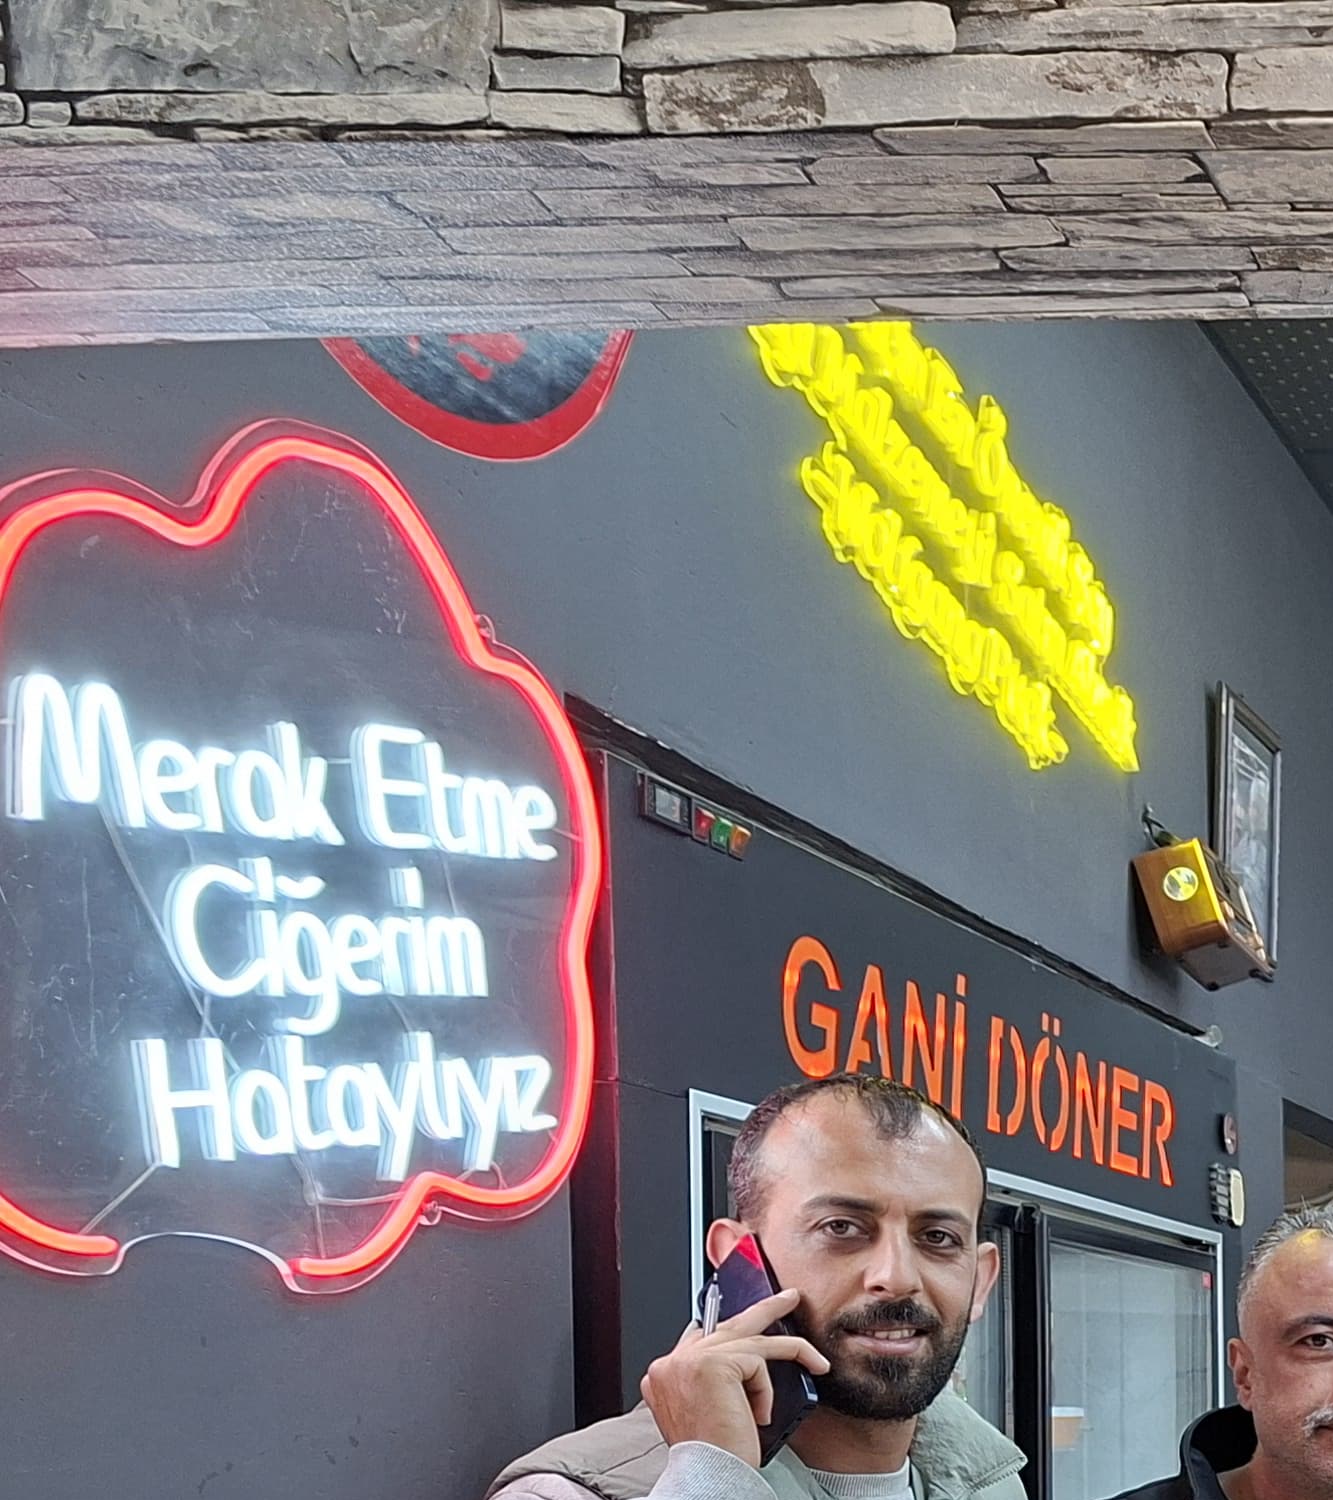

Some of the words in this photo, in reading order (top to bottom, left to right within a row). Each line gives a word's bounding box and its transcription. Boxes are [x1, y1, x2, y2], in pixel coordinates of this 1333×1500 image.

[6, 673, 344, 847] Merak
[350, 726, 558, 861] Etme
[163, 856, 489, 1036] Ciğerim
[130, 1031, 558, 1181] Hataylıyız
[781, 936, 968, 1118] GANİ
[986, 1012, 1174, 1187] DÖNER
